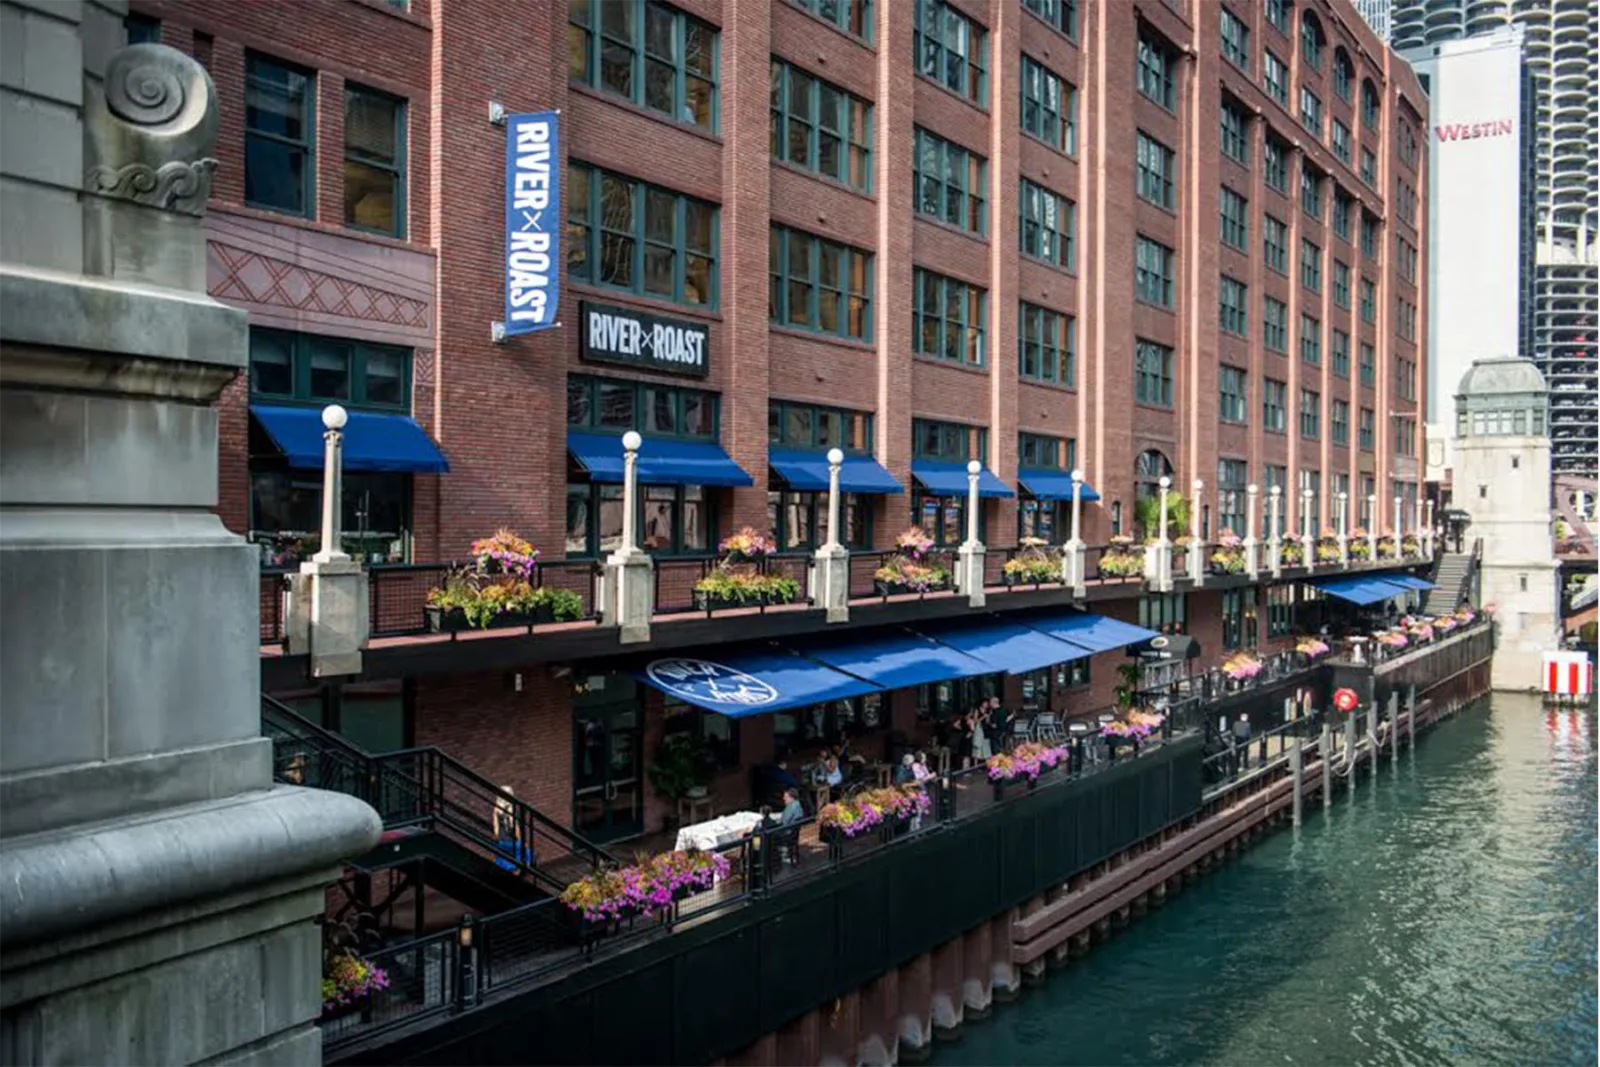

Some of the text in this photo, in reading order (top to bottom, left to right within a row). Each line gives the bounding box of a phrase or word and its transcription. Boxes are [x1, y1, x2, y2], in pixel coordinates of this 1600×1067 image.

[513, 121, 550, 209] RIVER
[1433, 119, 1513, 142] WESTIN
[509, 231, 550, 323] ROAST
[589, 311, 641, 356] RIVER
[653, 323, 705, 365] ROAST
